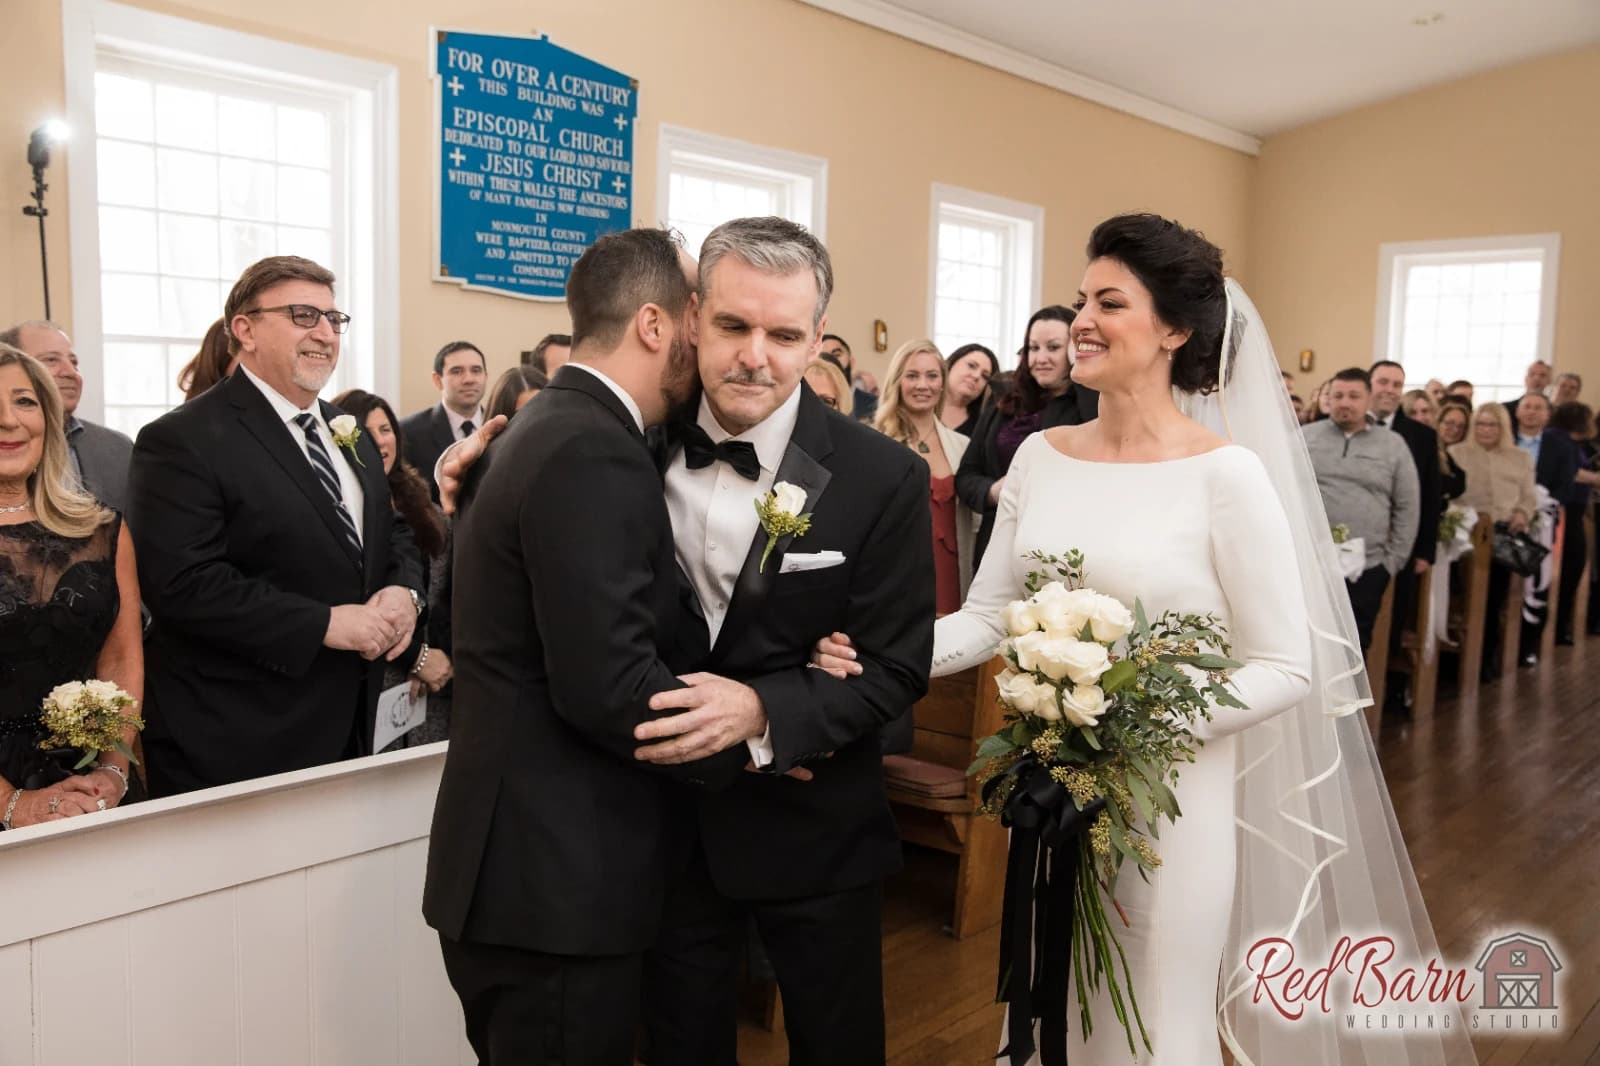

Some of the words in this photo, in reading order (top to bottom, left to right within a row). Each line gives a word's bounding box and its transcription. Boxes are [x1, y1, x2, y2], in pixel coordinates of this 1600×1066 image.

[448, 47, 484, 74] FOR
[491, 58, 540, 87] OVER
[545, 72, 558, 92] A
[561, 74, 631, 107] CENTURY
[478, 77, 508, 96] THIS
[517, 86, 576, 111] BUILDING
[581, 101, 604, 117] WAS
[532, 107, 553, 122] AN
[453, 106, 550, 143] EPISCOPAL
[559, 128, 624, 157] CHURCH
[444, 128, 503, 151] DEDICATED
[507, 139, 522, 155] TO
[524, 143, 547, 160] OUR
[550, 147, 576, 165] LORD
[577, 152, 596, 167] AND
[480, 152, 534, 179] JESUS
[543, 163, 602, 190] CHRIST
[448, 169, 485, 187] WITHIN
[489, 176, 522, 194] THESE
[523, 181, 556, 199] WALLS
[558, 186, 578, 201] THE
[580, 189, 628, 210] ANCESTORS
[469, 189, 482, 201] OF
[485, 191, 512, 206] MANY
[514, 195, 556, 212] FAMILIES
[557, 202, 575, 214] NOW
[491, 220, 547, 237] MONMOUTH
[551, 228, 587, 243] COUNTY
[535, 212, 548, 224] IN
[475, 231, 503, 246] WERE
[484, 247, 506, 260] AND
[508, 250, 554, 265] ADMITTED
[556, 254, 569, 267] TO
